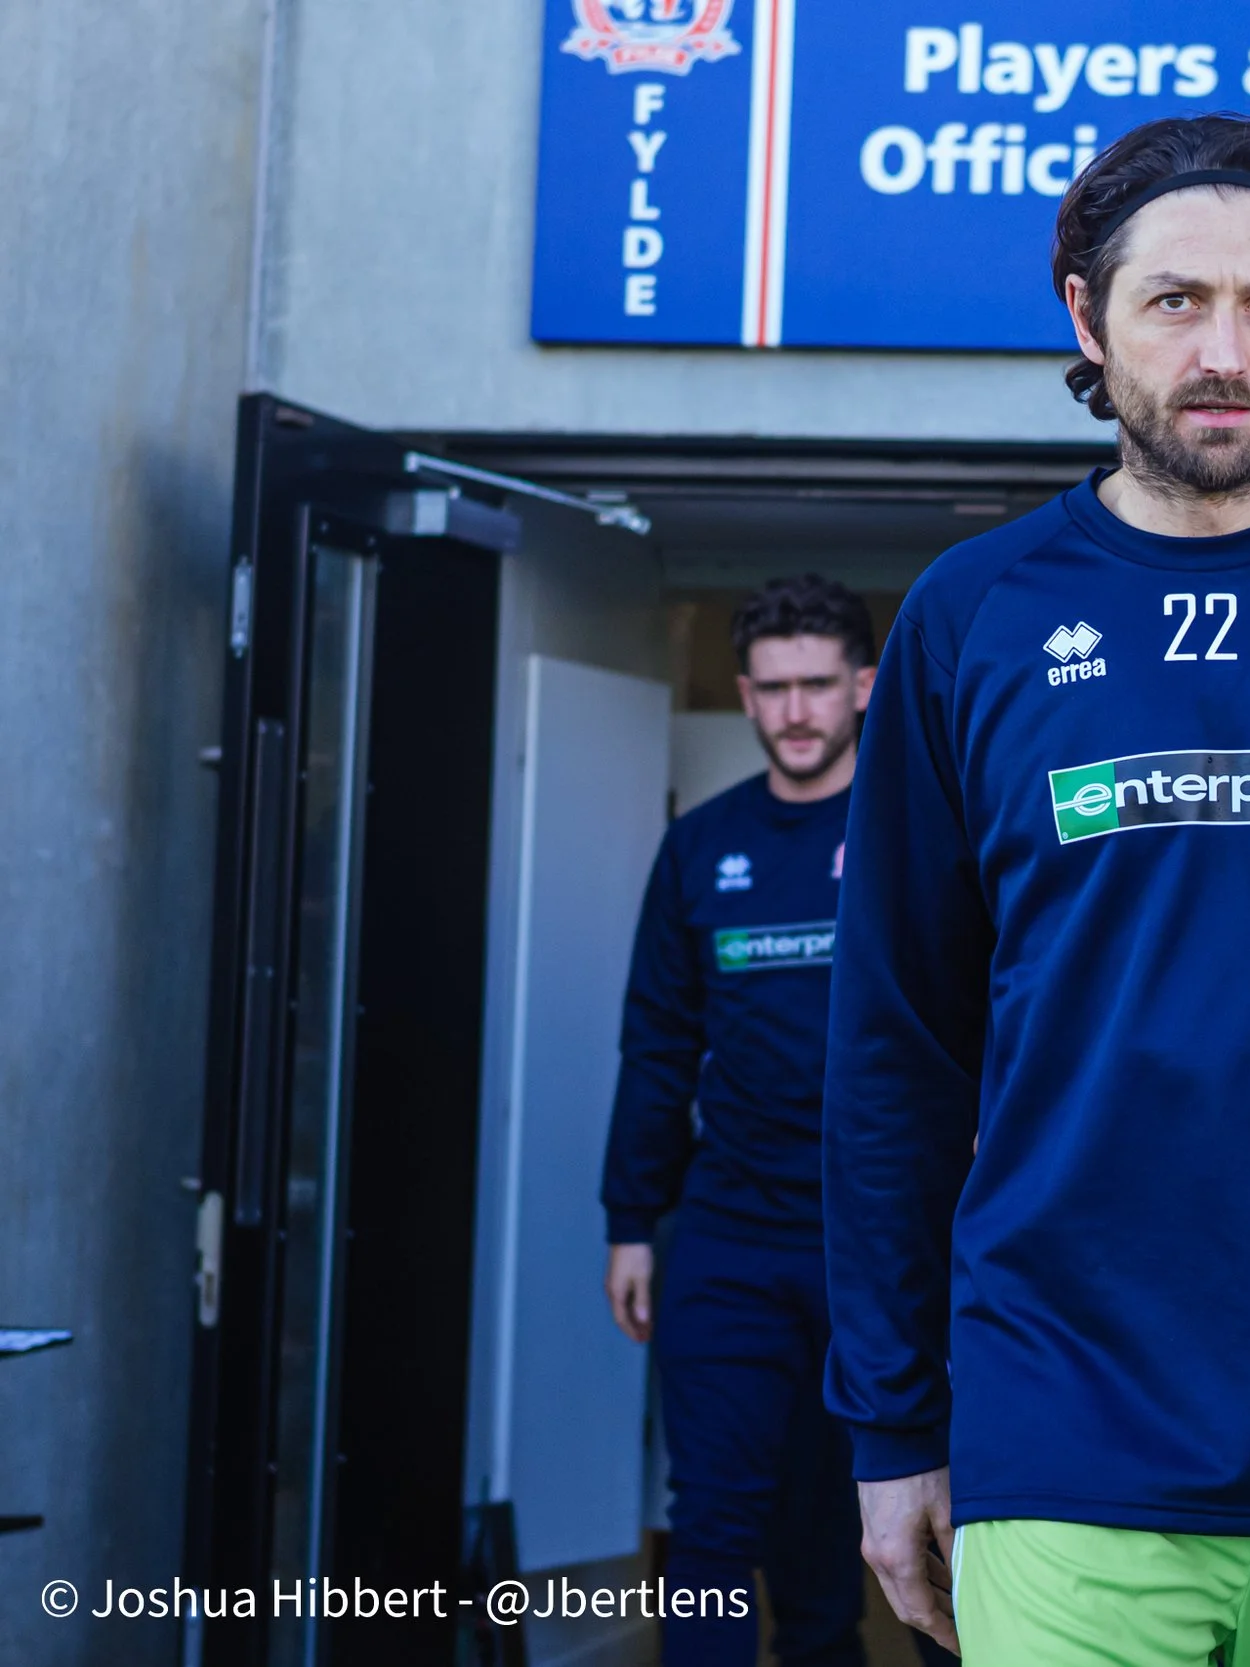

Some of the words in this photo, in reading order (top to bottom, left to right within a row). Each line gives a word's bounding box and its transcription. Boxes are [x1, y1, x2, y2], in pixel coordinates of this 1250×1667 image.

[904, 23, 1218, 112] Players
[860, 122, 1098, 197] Offici
[624, 83, 666, 316] FYLDE
[1163, 592, 1239, 662] 22
[720, 932, 836, 959] enterpr
